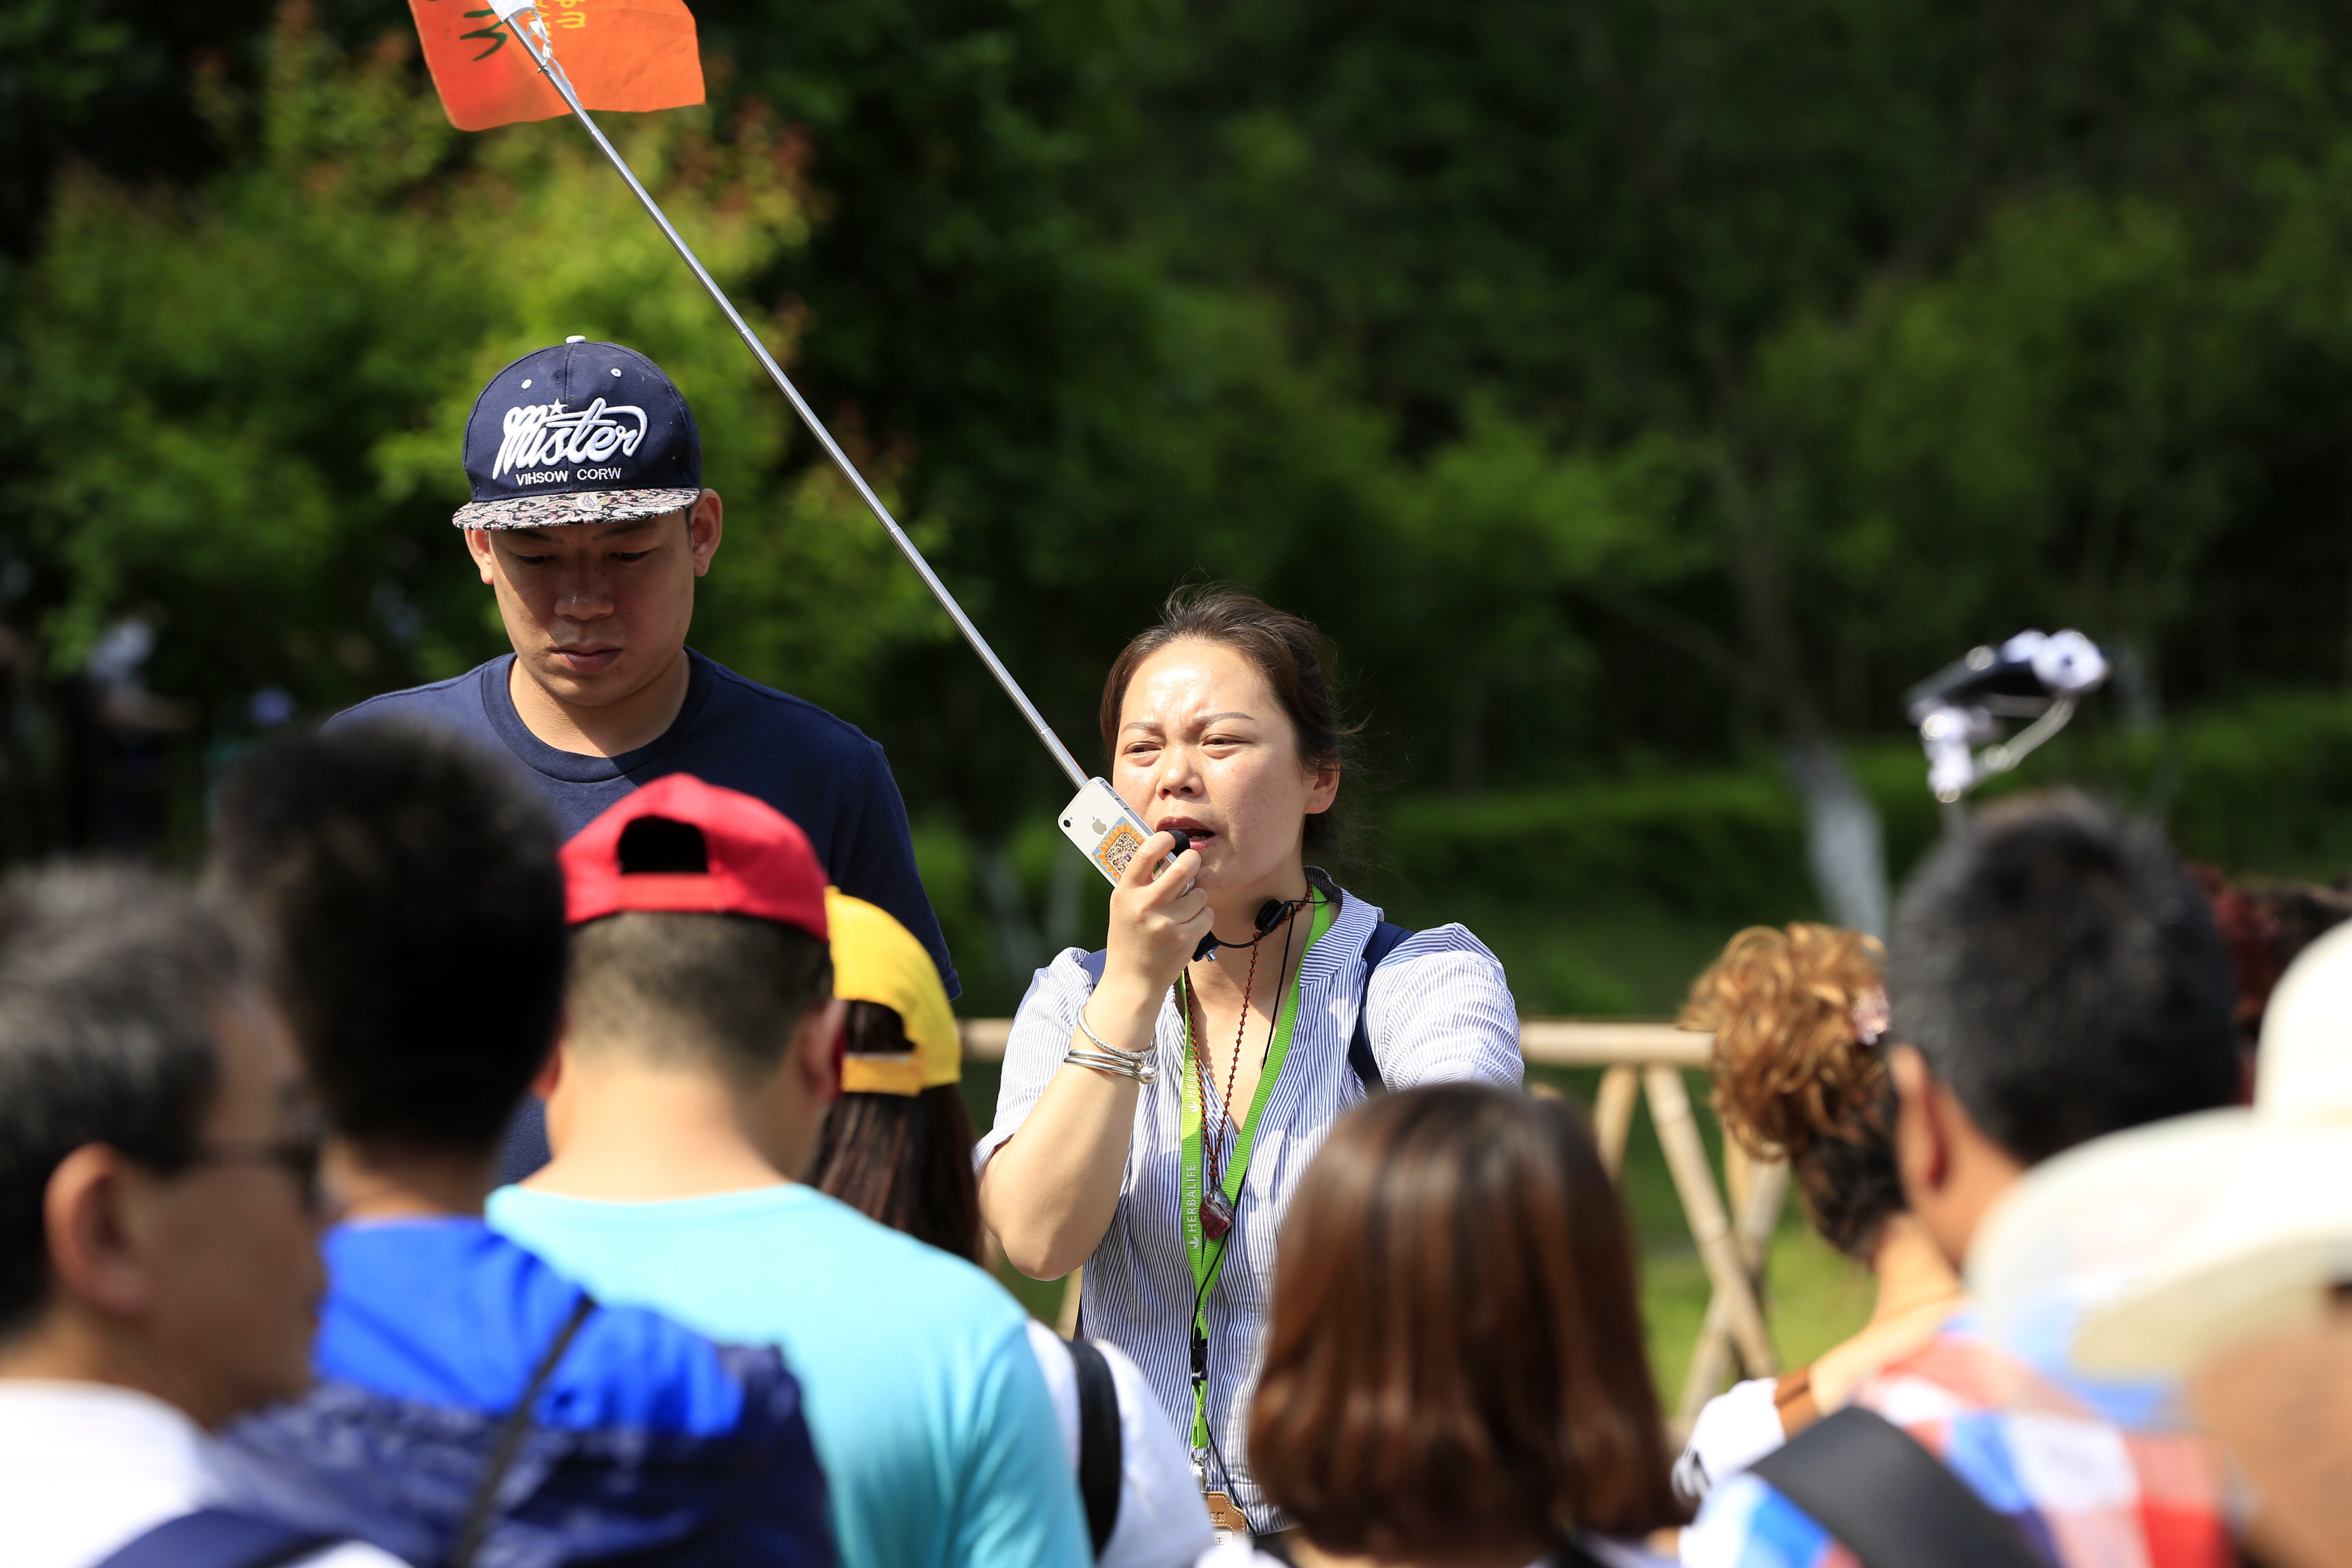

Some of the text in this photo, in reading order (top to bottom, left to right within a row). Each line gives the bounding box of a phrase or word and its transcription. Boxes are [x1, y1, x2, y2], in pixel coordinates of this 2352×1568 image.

[492, 397, 648, 480] Mister
[515, 467, 622, 486] VIHSOW CORW
[1187, 1165, 1197, 1232] HERBALIFE
